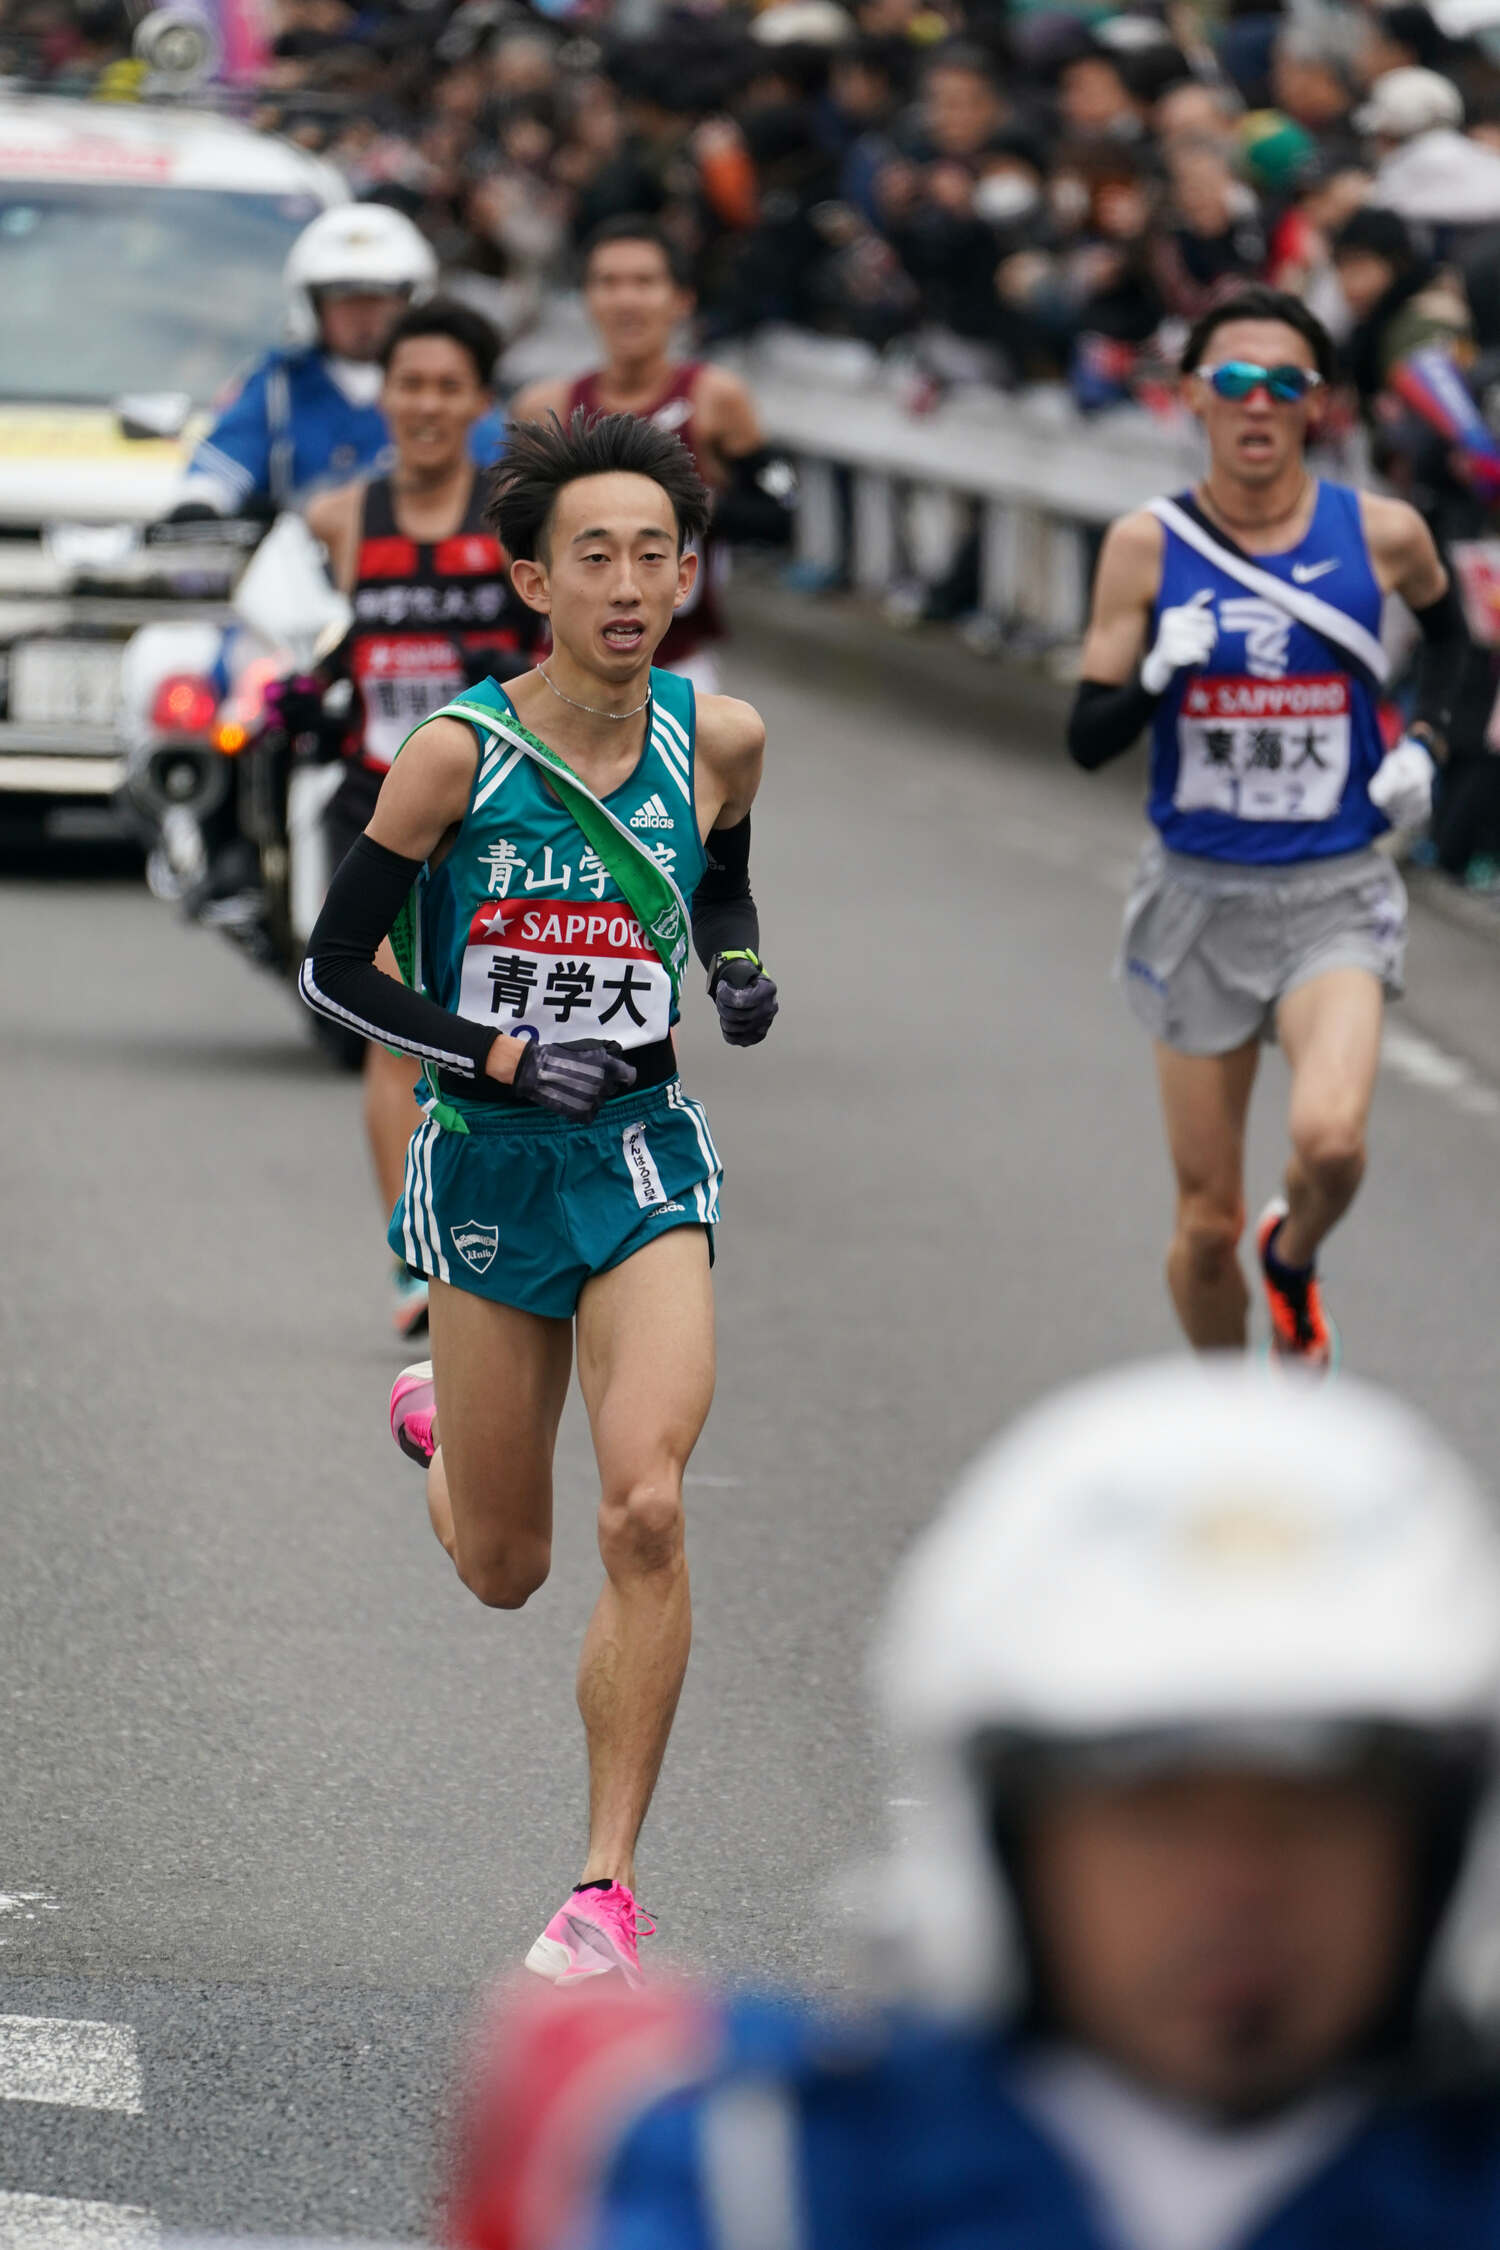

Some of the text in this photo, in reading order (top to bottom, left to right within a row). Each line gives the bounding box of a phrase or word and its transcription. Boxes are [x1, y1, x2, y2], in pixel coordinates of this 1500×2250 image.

[1217, 682, 1346, 714] SAPPORO
[1204, 724, 1328, 772] 東海大
[629, 815, 675, 829] adidas
[487, 954, 652, 1028] 青学大
